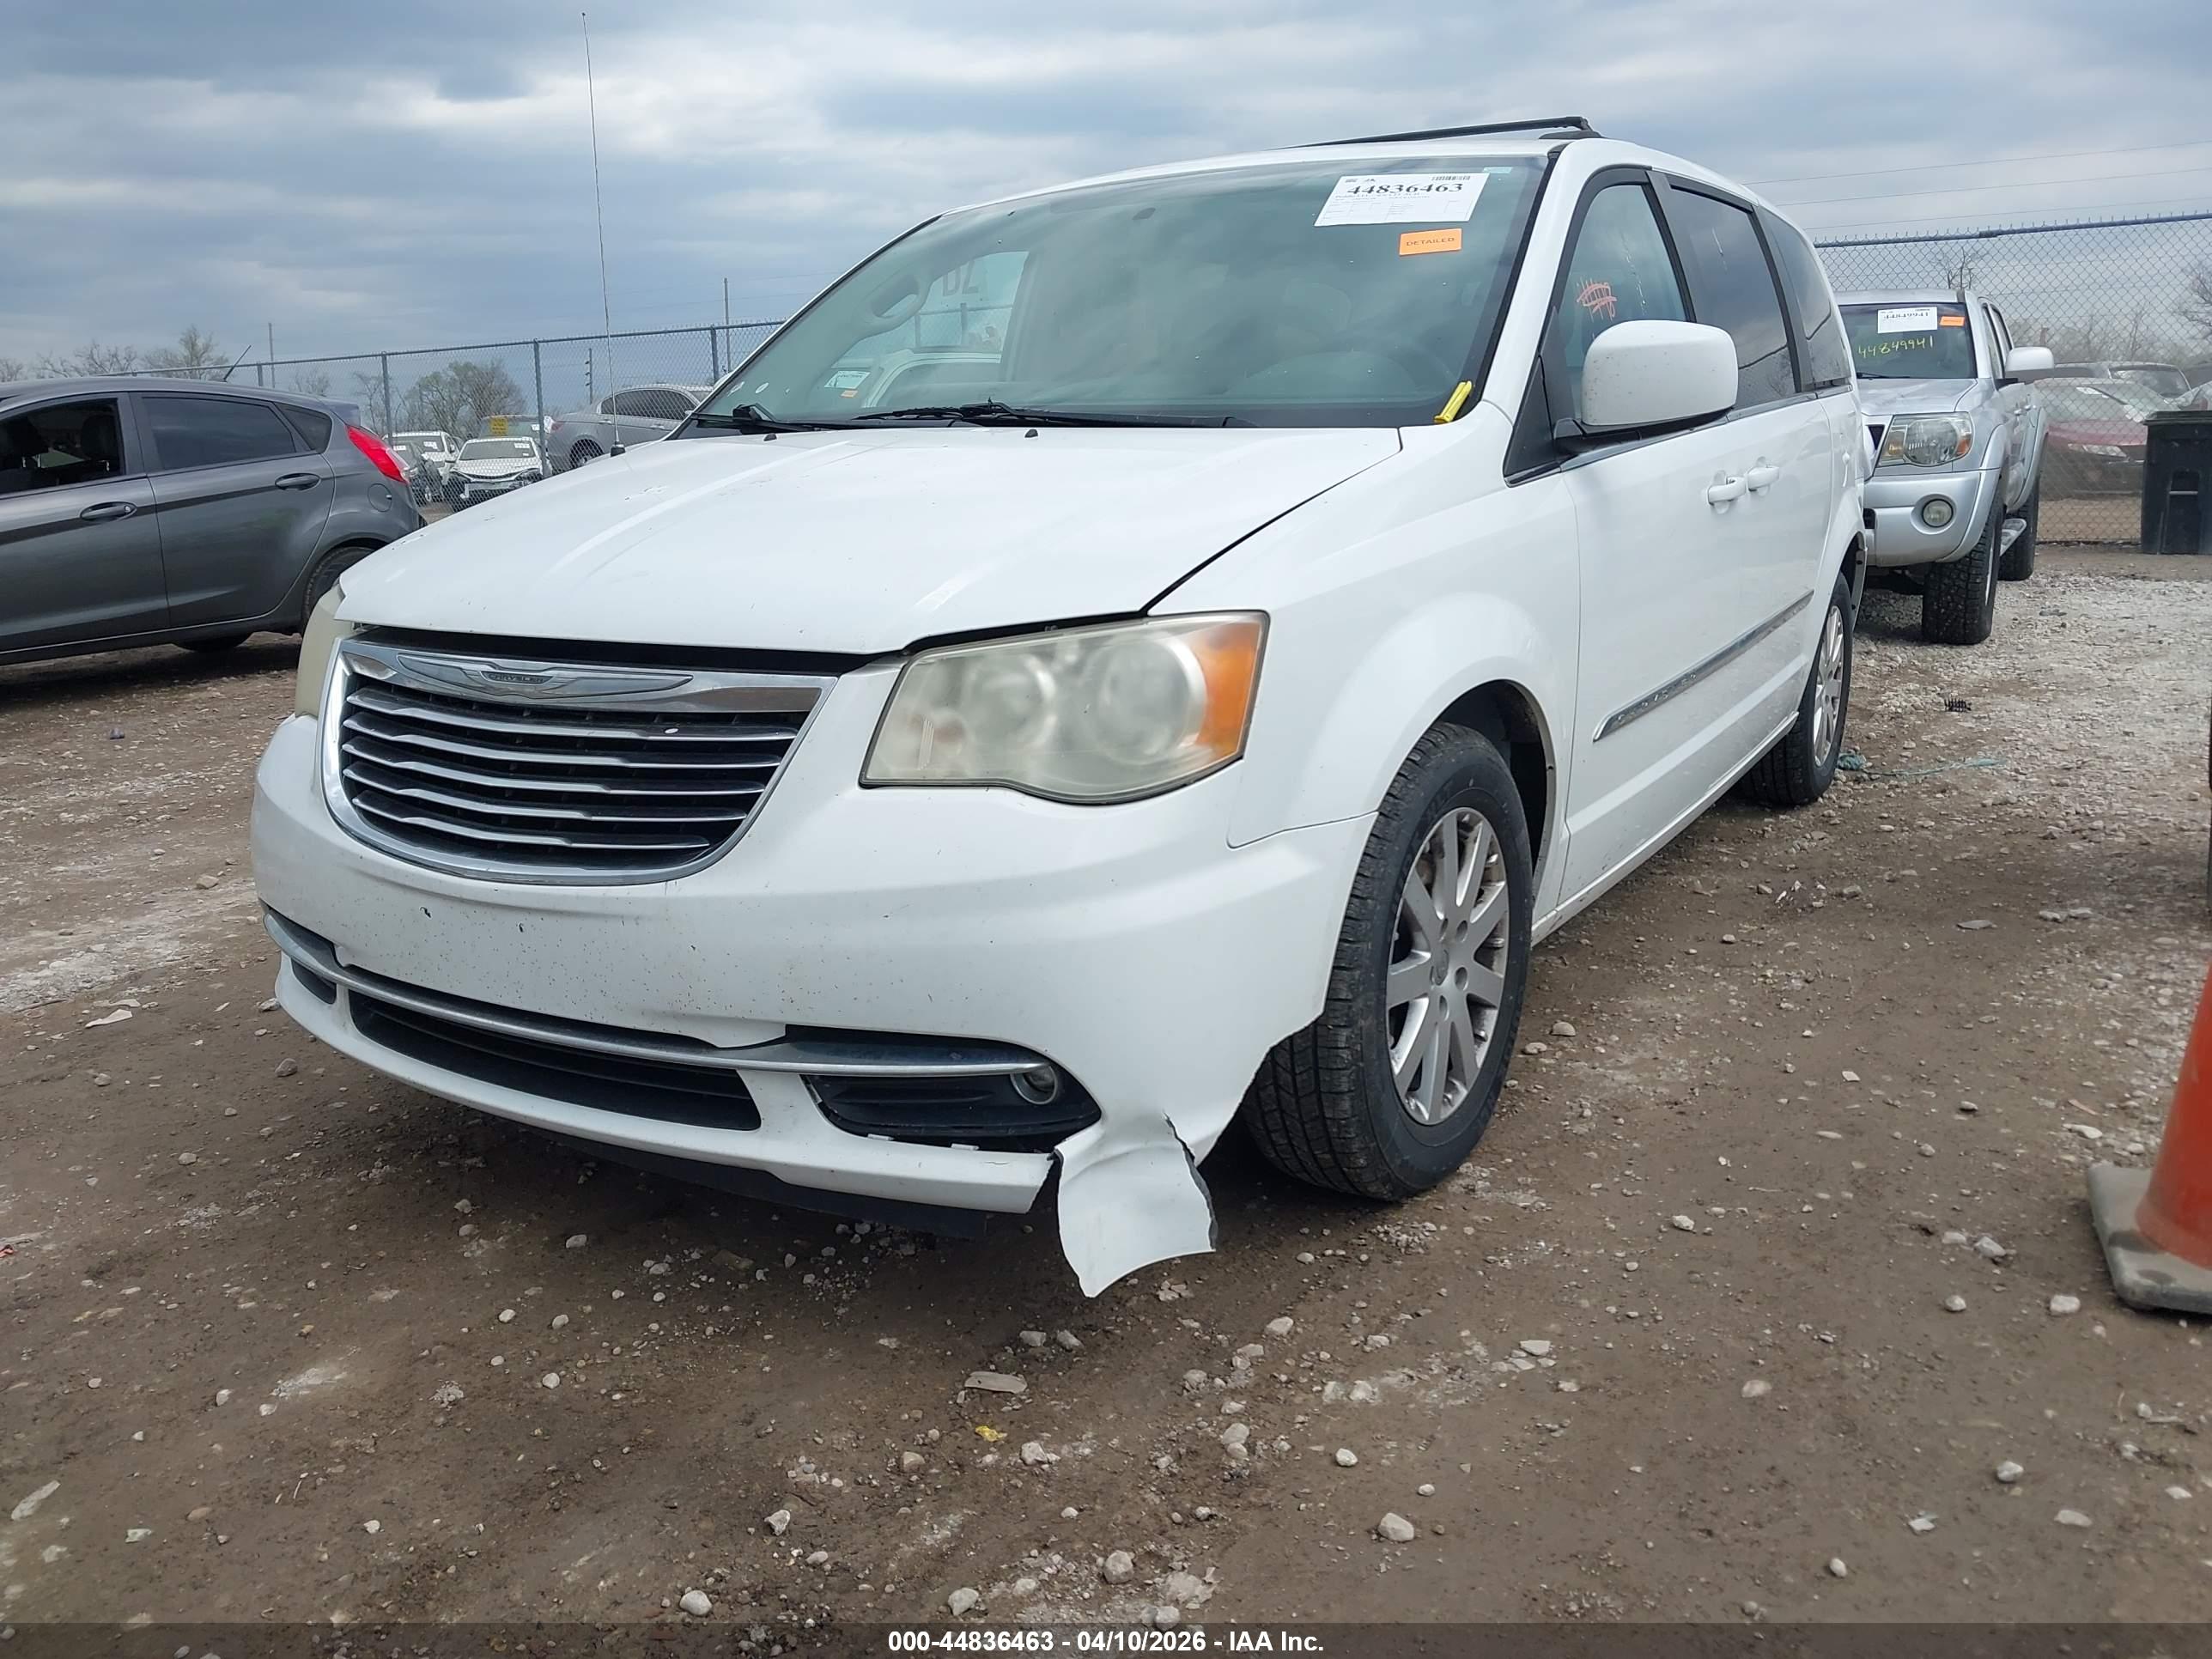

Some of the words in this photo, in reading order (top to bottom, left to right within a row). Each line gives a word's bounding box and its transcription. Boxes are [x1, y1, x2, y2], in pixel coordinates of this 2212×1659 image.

[1346, 183, 1463, 195] 44836463
[1406, 237, 1455, 246] DETAILED
[1857, 335, 1934, 358] 44849941
[488, 673, 544, 684] CHRYSLER
